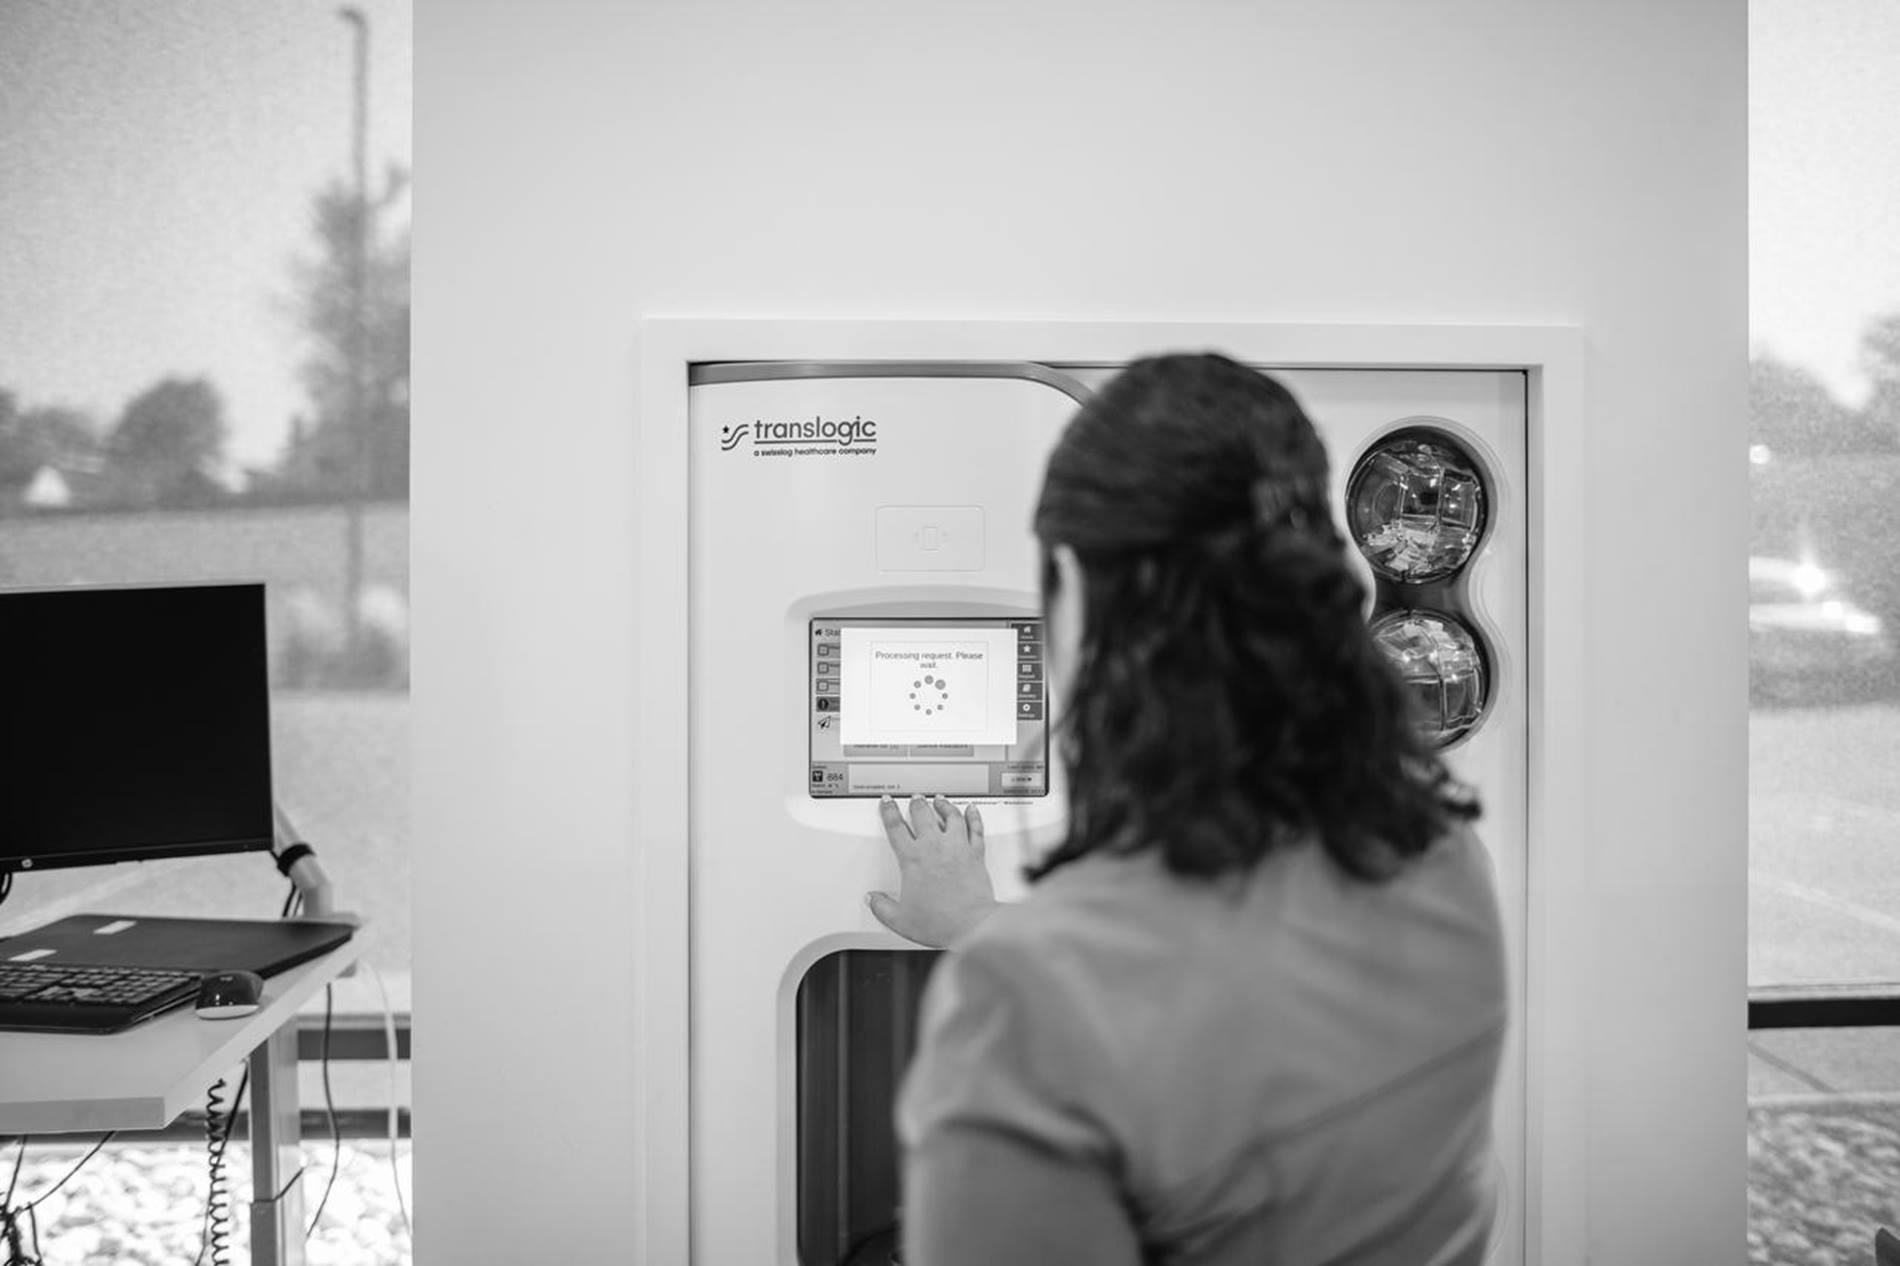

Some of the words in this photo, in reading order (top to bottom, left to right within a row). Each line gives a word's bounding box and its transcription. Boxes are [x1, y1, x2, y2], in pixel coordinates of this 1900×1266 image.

[754, 415, 877, 446] translogic
[761, 448, 793, 457] swisslog
[794, 447, 837, 455] healthcare
[838, 447, 877, 455] company
[875, 650, 920, 661] Processing
[955, 650, 984, 660] Please
